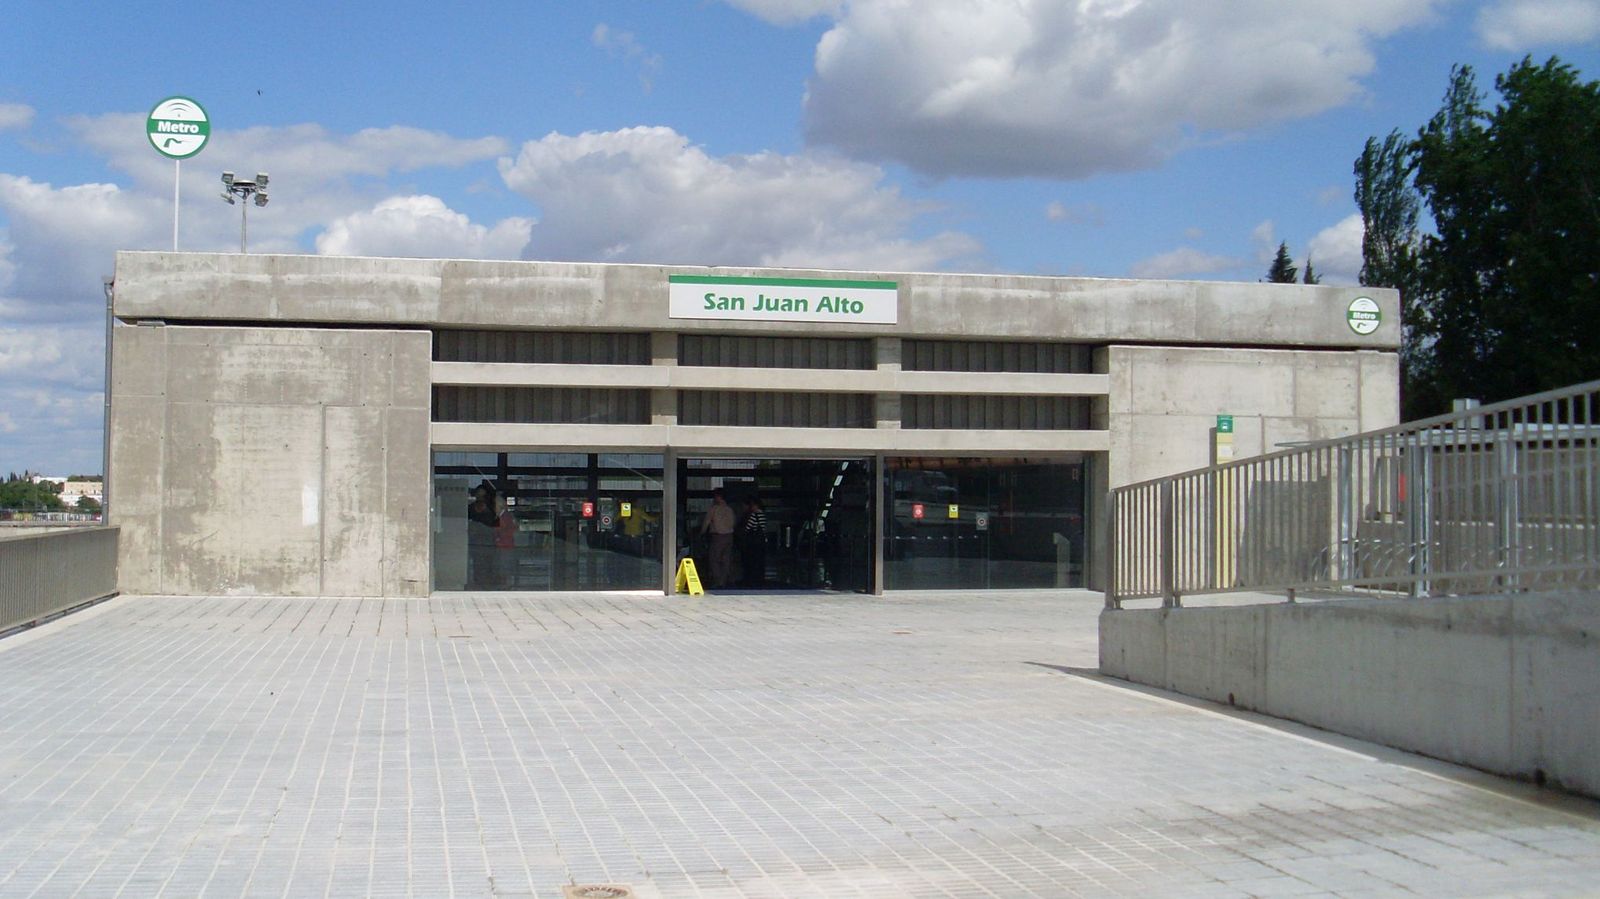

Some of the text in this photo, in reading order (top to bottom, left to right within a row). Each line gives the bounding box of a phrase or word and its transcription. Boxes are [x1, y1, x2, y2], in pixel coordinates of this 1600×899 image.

[158, 121, 199, 133] Metro
[704, 293, 864, 314] San Juan Alto
[1352, 312, 1376, 320] Metro
